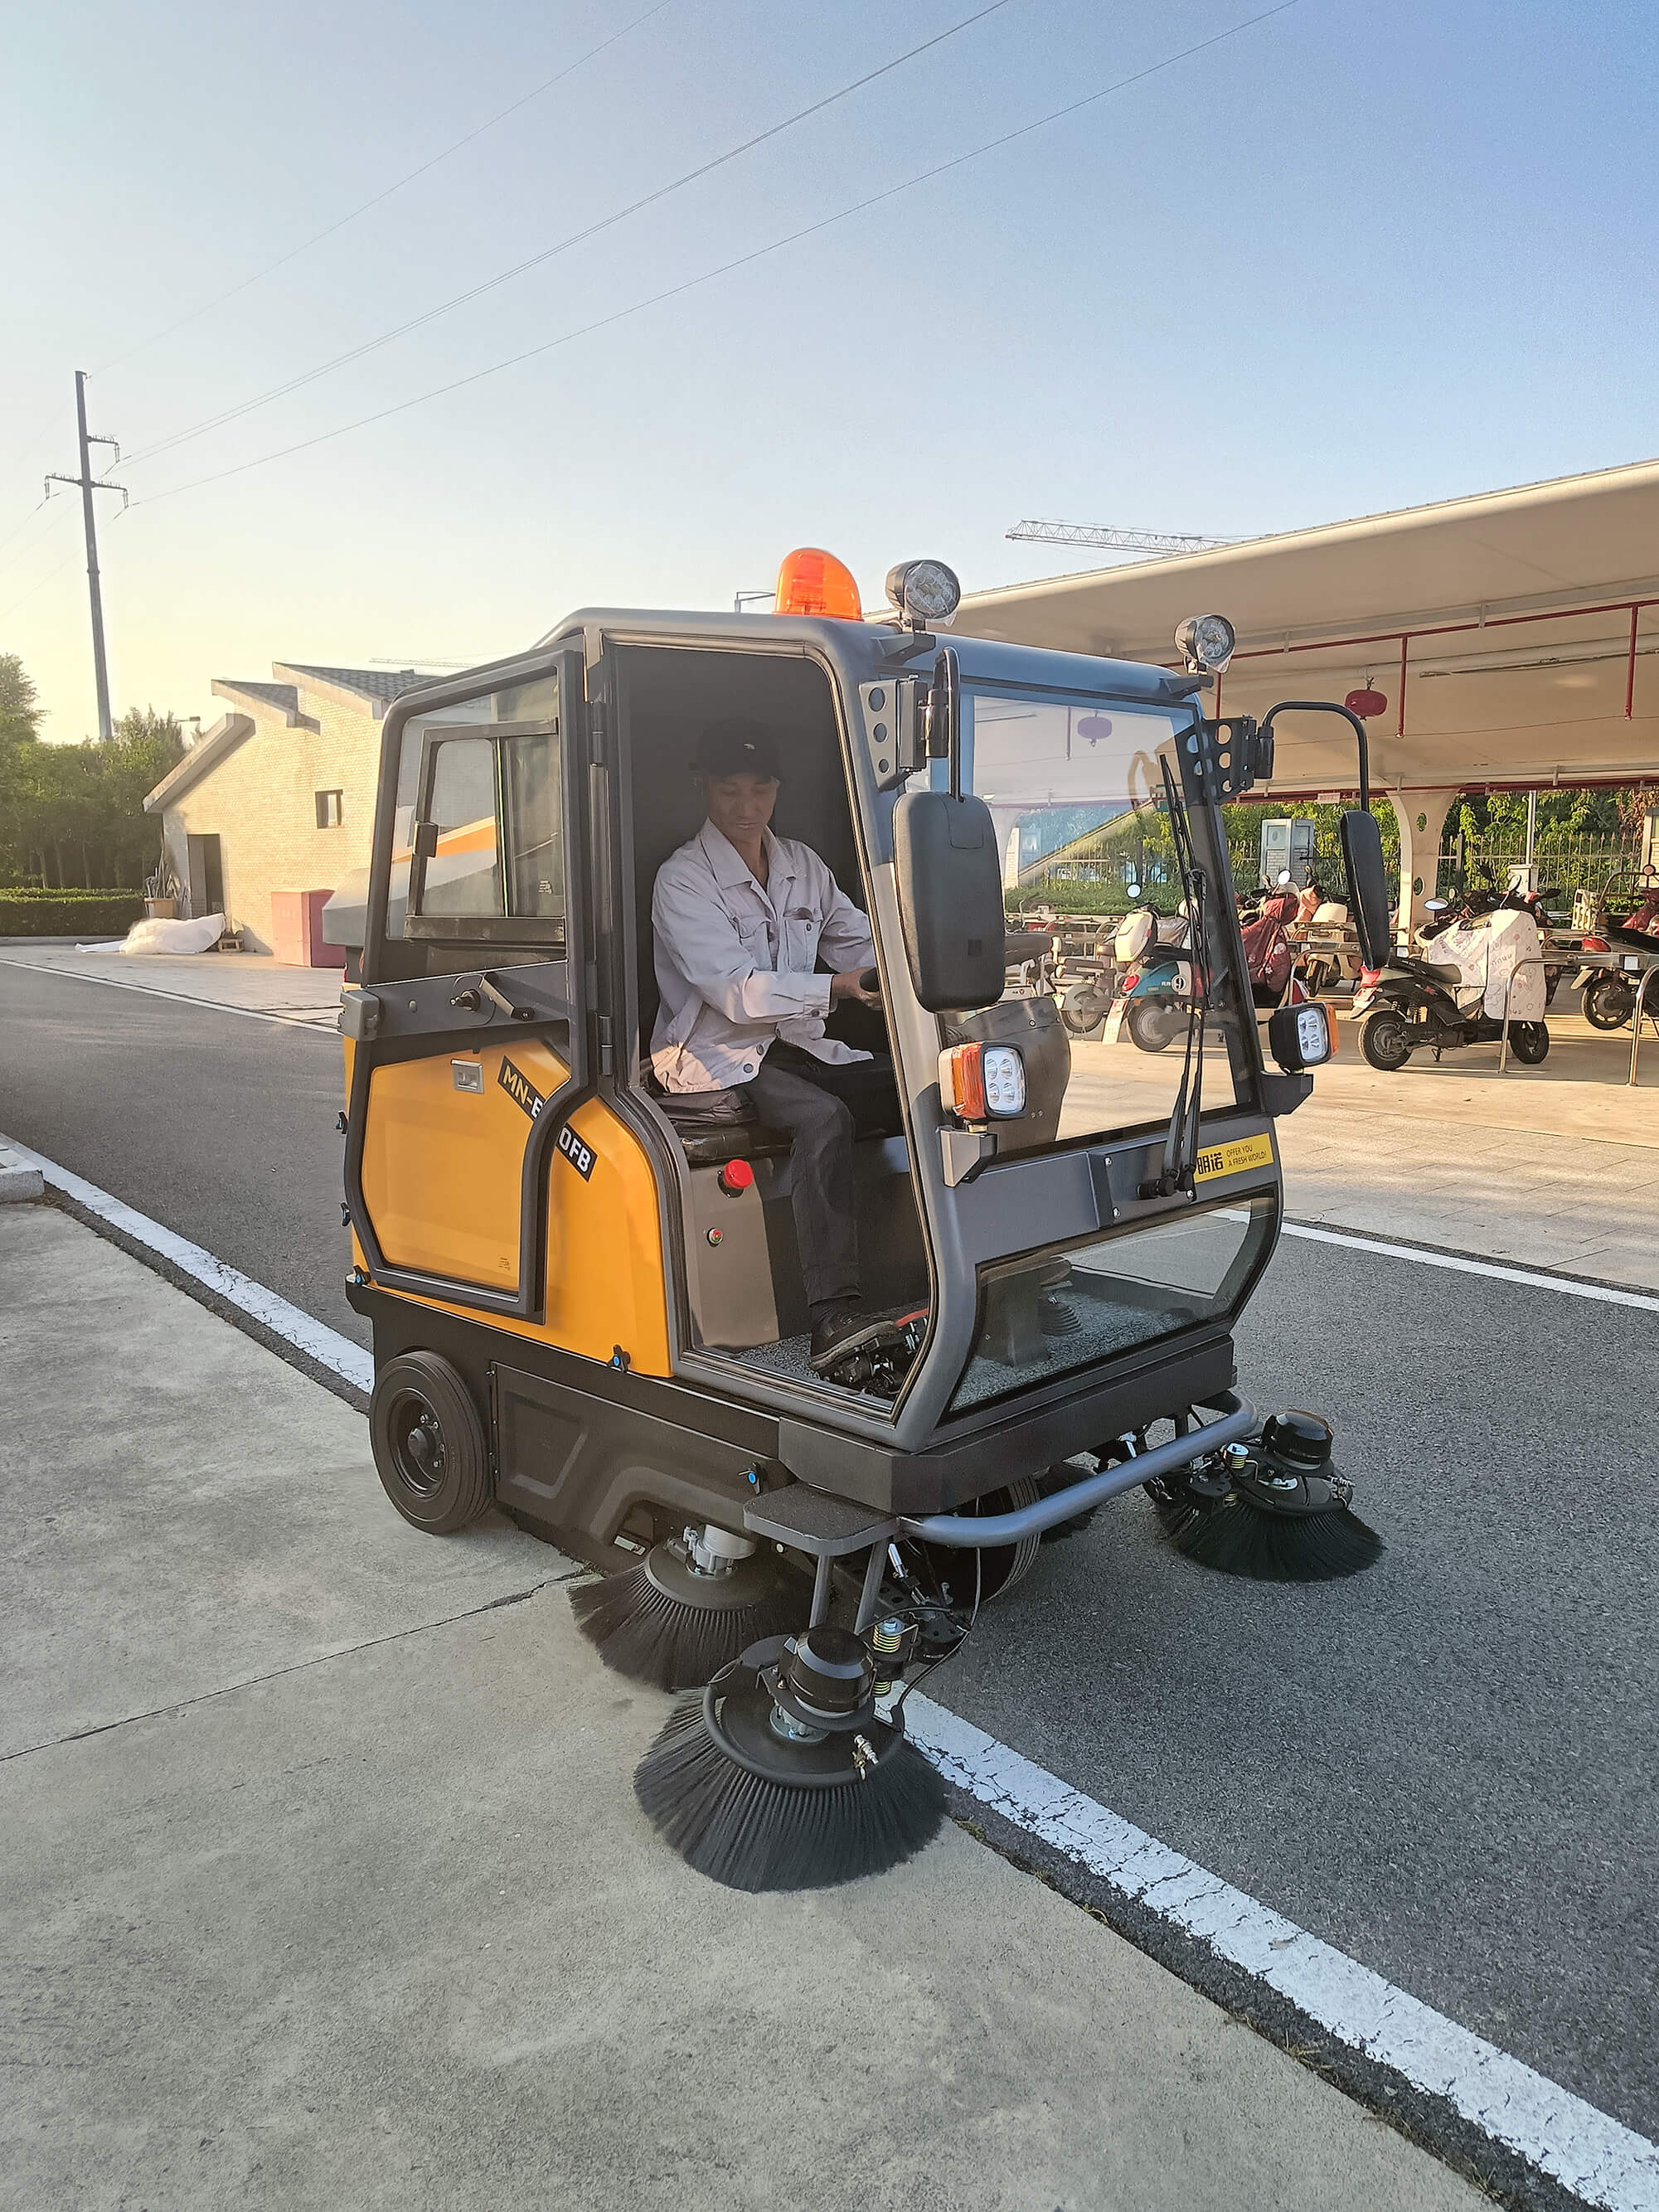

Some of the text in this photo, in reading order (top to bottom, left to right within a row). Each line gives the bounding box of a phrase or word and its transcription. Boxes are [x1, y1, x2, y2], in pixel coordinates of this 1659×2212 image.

[1226, 1144, 1253, 1157] OFFER YOU
[1197, 1152, 1224, 1174] 明诺
[1233, 1156, 1248, 1167] FRESH
